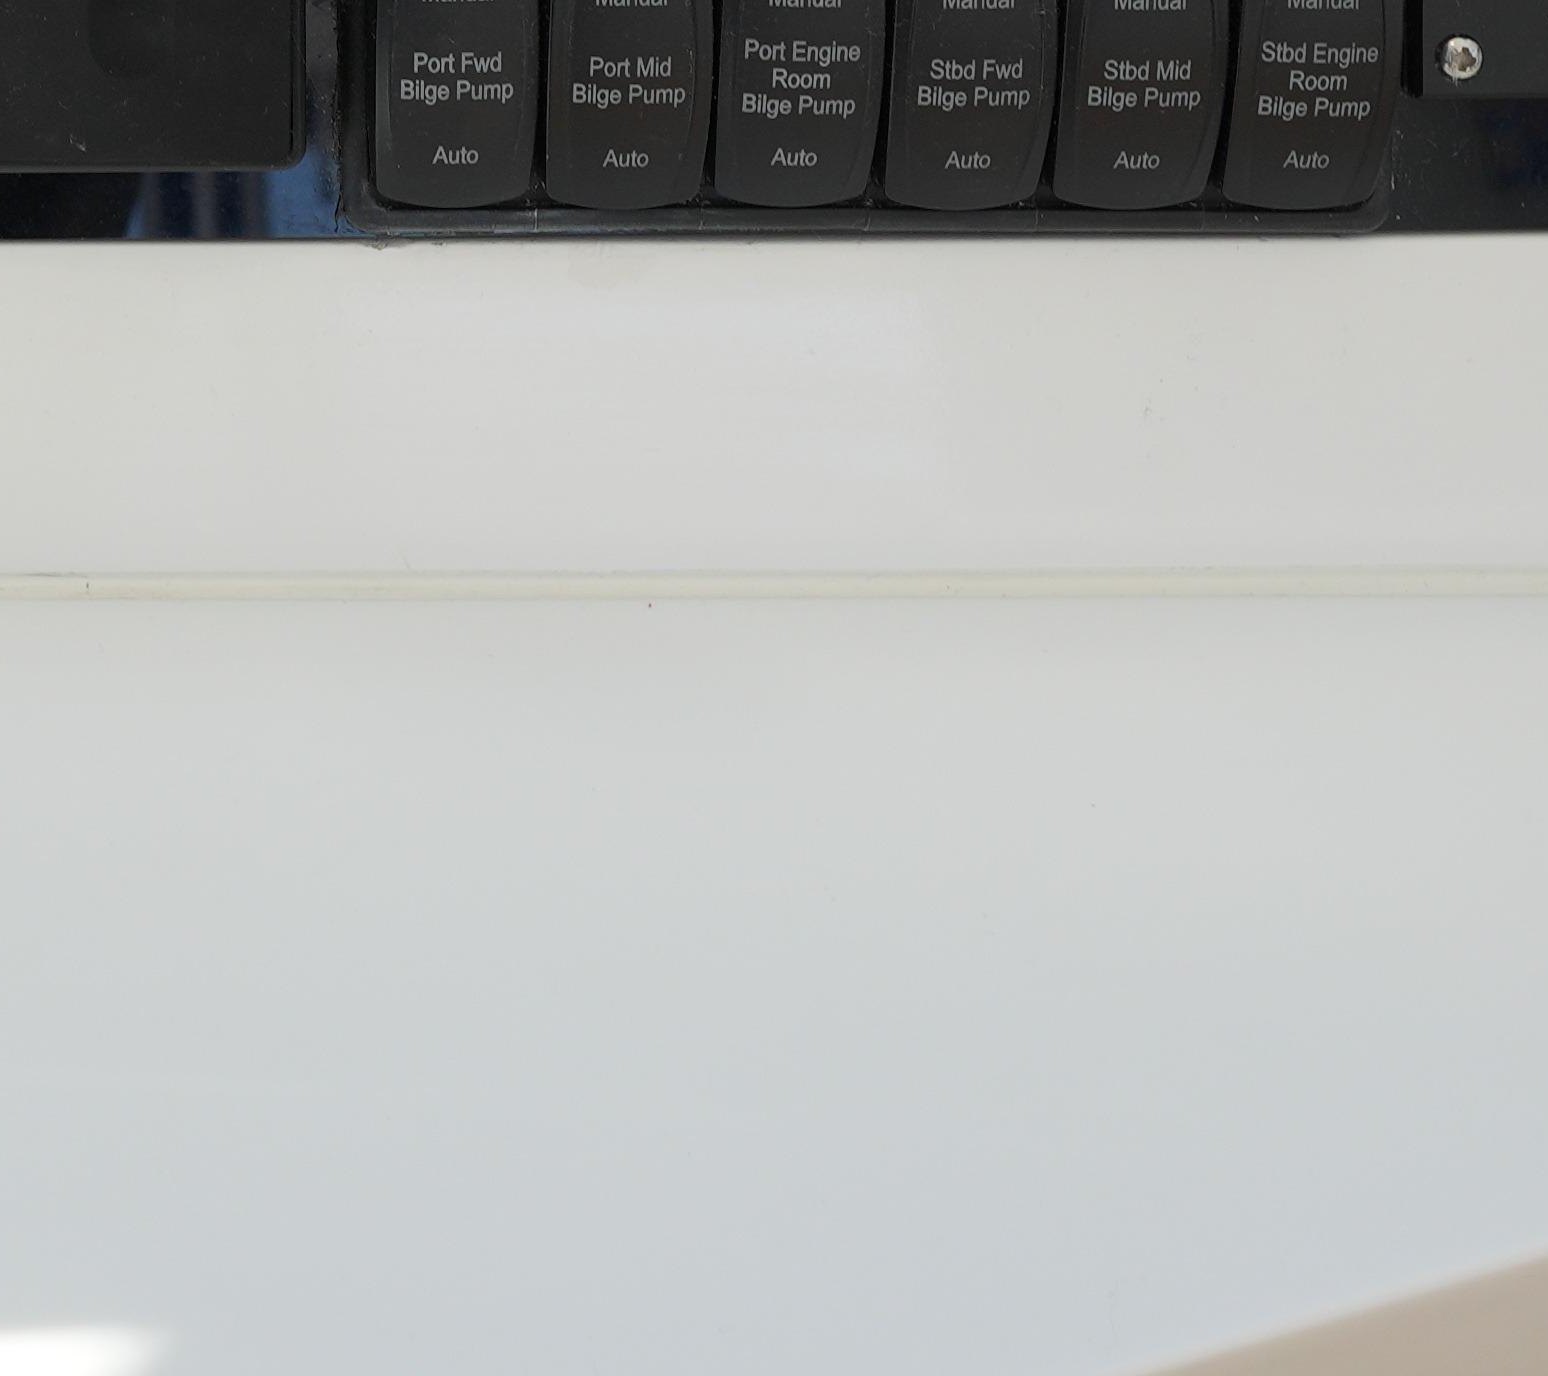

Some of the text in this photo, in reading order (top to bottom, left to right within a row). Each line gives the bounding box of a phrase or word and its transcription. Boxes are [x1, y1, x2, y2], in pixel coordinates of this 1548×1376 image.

[413, 51, 502, 74] Port Fwd
[744, 38, 861, 68] Port Engine
[1261, 40, 1379, 69] Stbd Engine
[589, 55, 672, 78] Port Mid
[930, 57, 1023, 81] Stbd Fwd
[1103, 59, 1192, 81] Stbd Mid
[772, 67, 831, 90] Room
[1289, 69, 1348, 91] Room
[400, 78, 514, 106] Bilge Pump
[572, 83, 686, 110] Bilge Pump
[917, 85, 1031, 112] Bilge Pump
[1087, 85, 1201, 113] Bilge Pump
[741, 92, 856, 120] Bilge Pump
[1257, 95, 1371, 122] Bilge Pump
[432, 145, 479, 165] Auto
[602, 149, 649, 168] Auto
[770, 147, 818, 167] Auto
[944, 150, 991, 169] Auto
[1113, 150, 1160, 170] Auto
[1283, 150, 1330, 169] Auto
